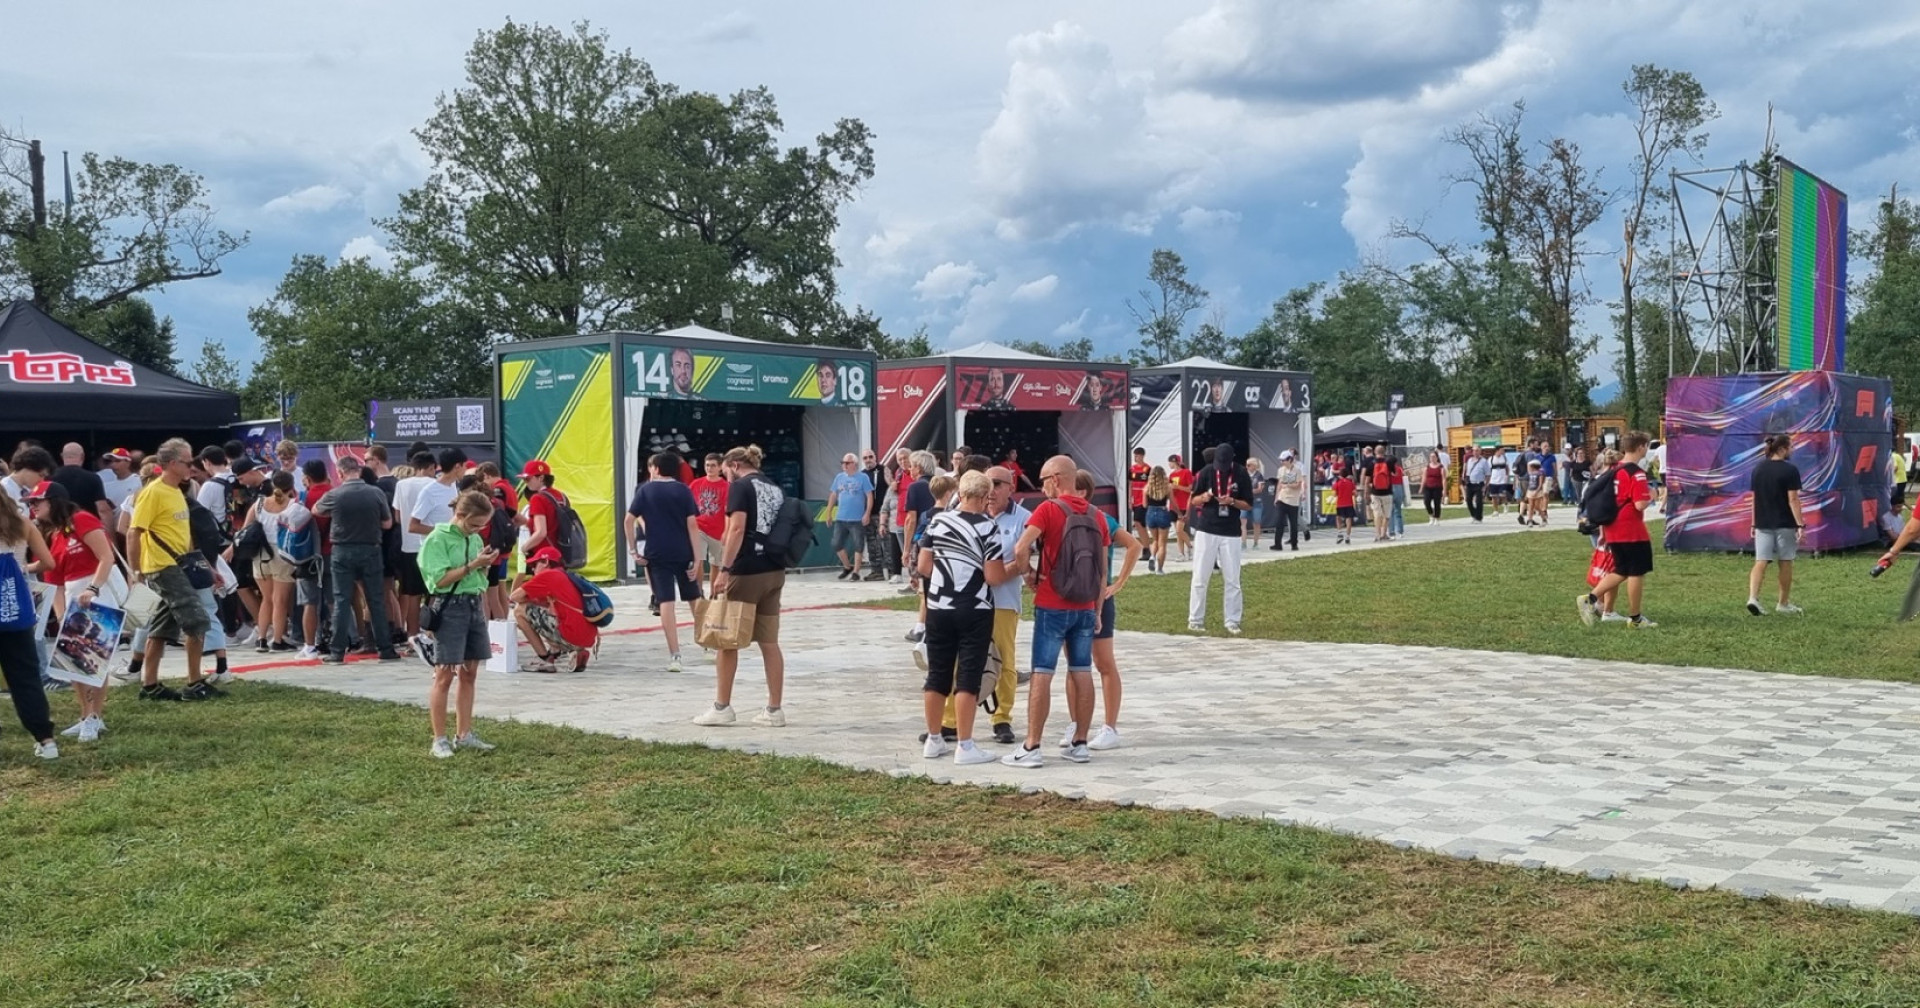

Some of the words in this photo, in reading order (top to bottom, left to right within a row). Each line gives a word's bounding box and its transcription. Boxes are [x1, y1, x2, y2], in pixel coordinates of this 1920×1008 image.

[631, 351, 670, 392] 14
[762, 375, 789, 384] aramco
[837, 366, 866, 401] 18
[960, 373, 988, 402] 77
[1191, 379, 1212, 407] 22
[1300, 383, 1311, 408] 3
[392, 407, 414, 415] SCAN
[414, 406, 427, 414] THE
[398, 414, 419, 422] CODE
[419, 429, 440, 437] SHOP
[423, 421, 438, 429] THE
